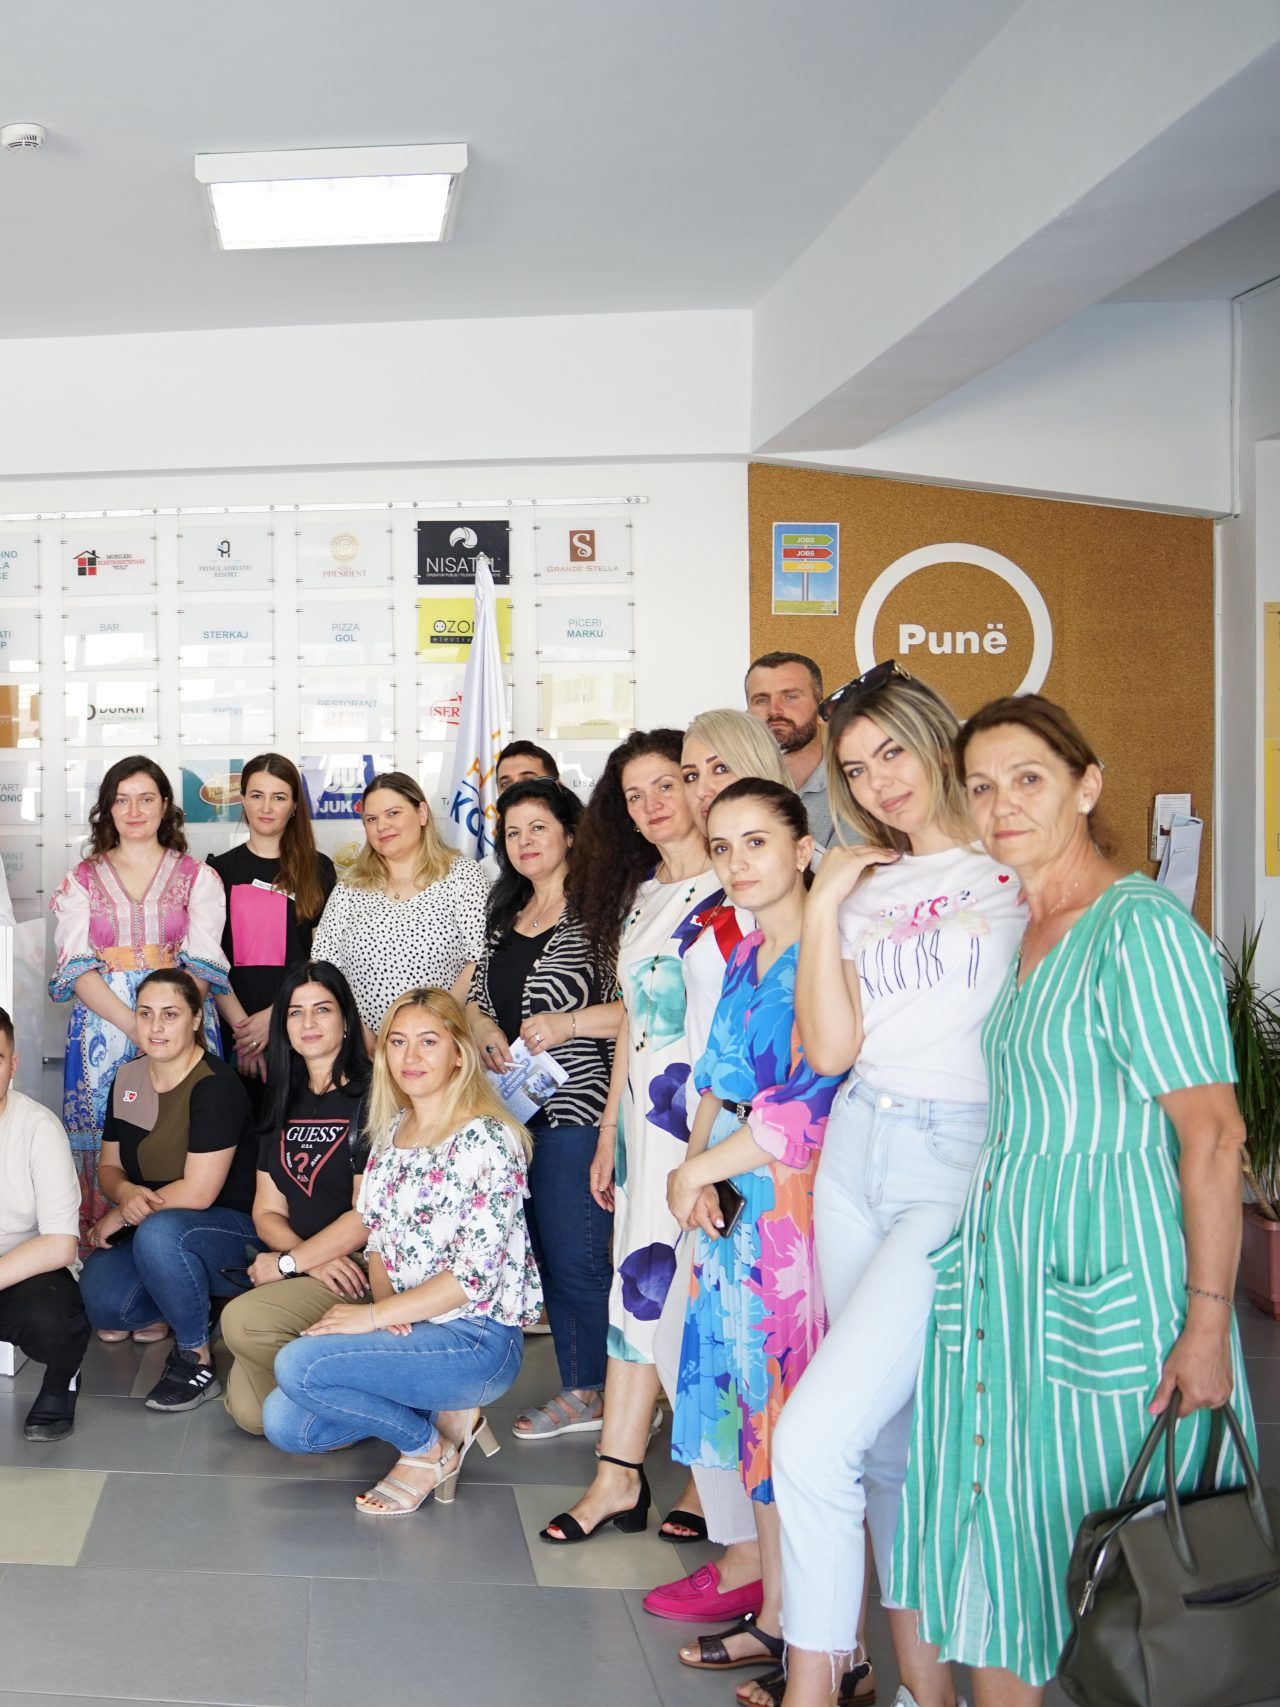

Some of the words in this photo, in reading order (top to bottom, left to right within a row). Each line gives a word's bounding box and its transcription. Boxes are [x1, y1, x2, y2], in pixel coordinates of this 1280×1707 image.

[426, 557, 501, 573] NISATL
[322, 570, 367, 578] PRESIDENT
[568, 618, 602, 627] PICERI
[100, 624, 120, 632] BAR
[332, 624, 360, 632] PIZZA
[203, 631, 248, 639] STERKAJ
[335, 634, 356, 642] GOL
[566, 630, 604, 638] MARKU
[899, 624, 1008, 655] Punë
[434, 706, 460, 718] SER
[286, 1126, 340, 1142] GUESS
